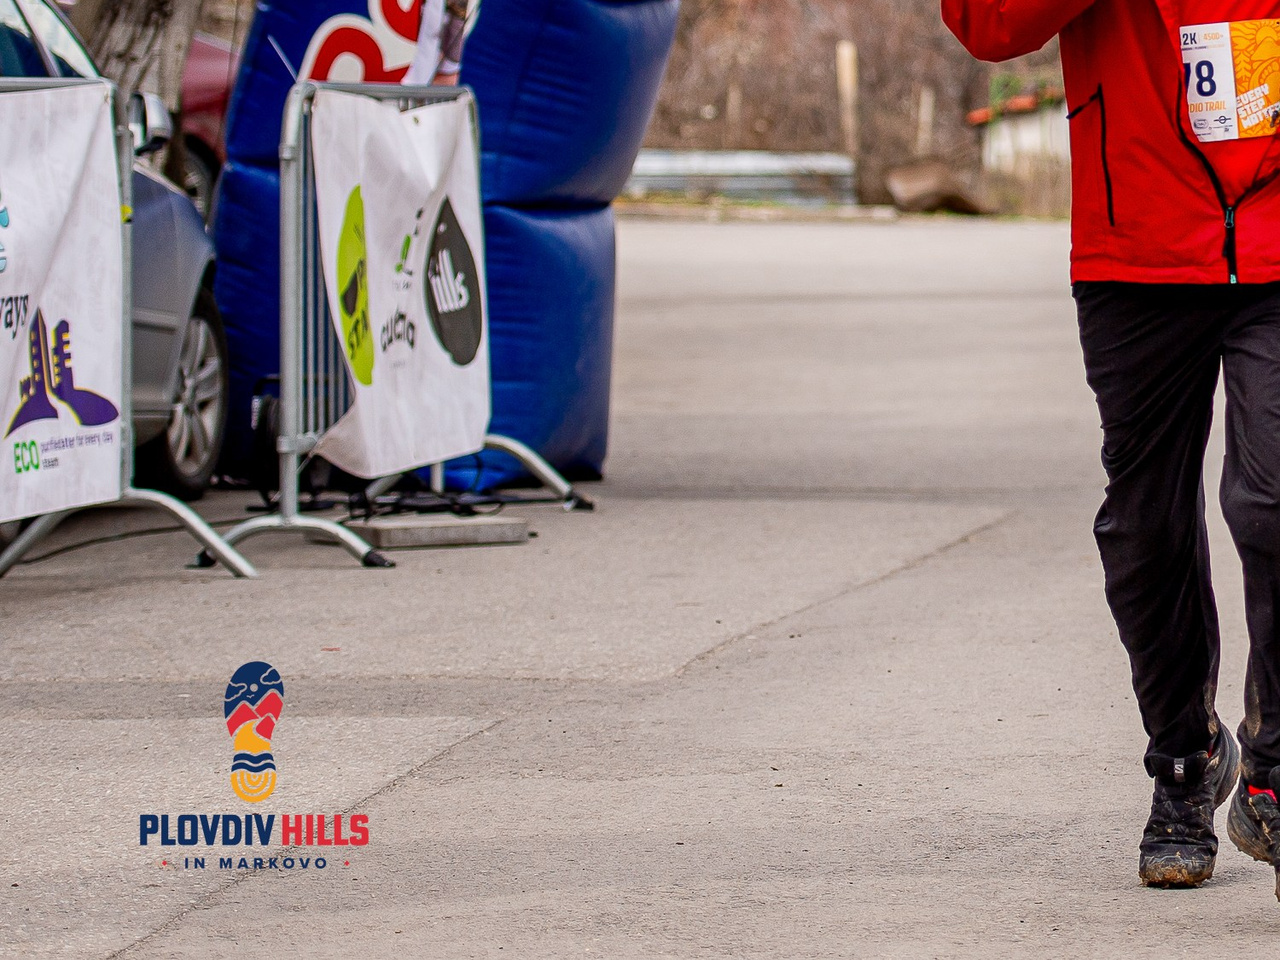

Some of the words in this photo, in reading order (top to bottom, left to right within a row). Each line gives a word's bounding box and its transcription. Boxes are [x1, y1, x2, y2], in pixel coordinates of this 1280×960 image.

[1206, 101, 1227, 112] TRAIL
[1237, 96, 1266, 118] STEP
[14, 440, 40, 474] ECO
